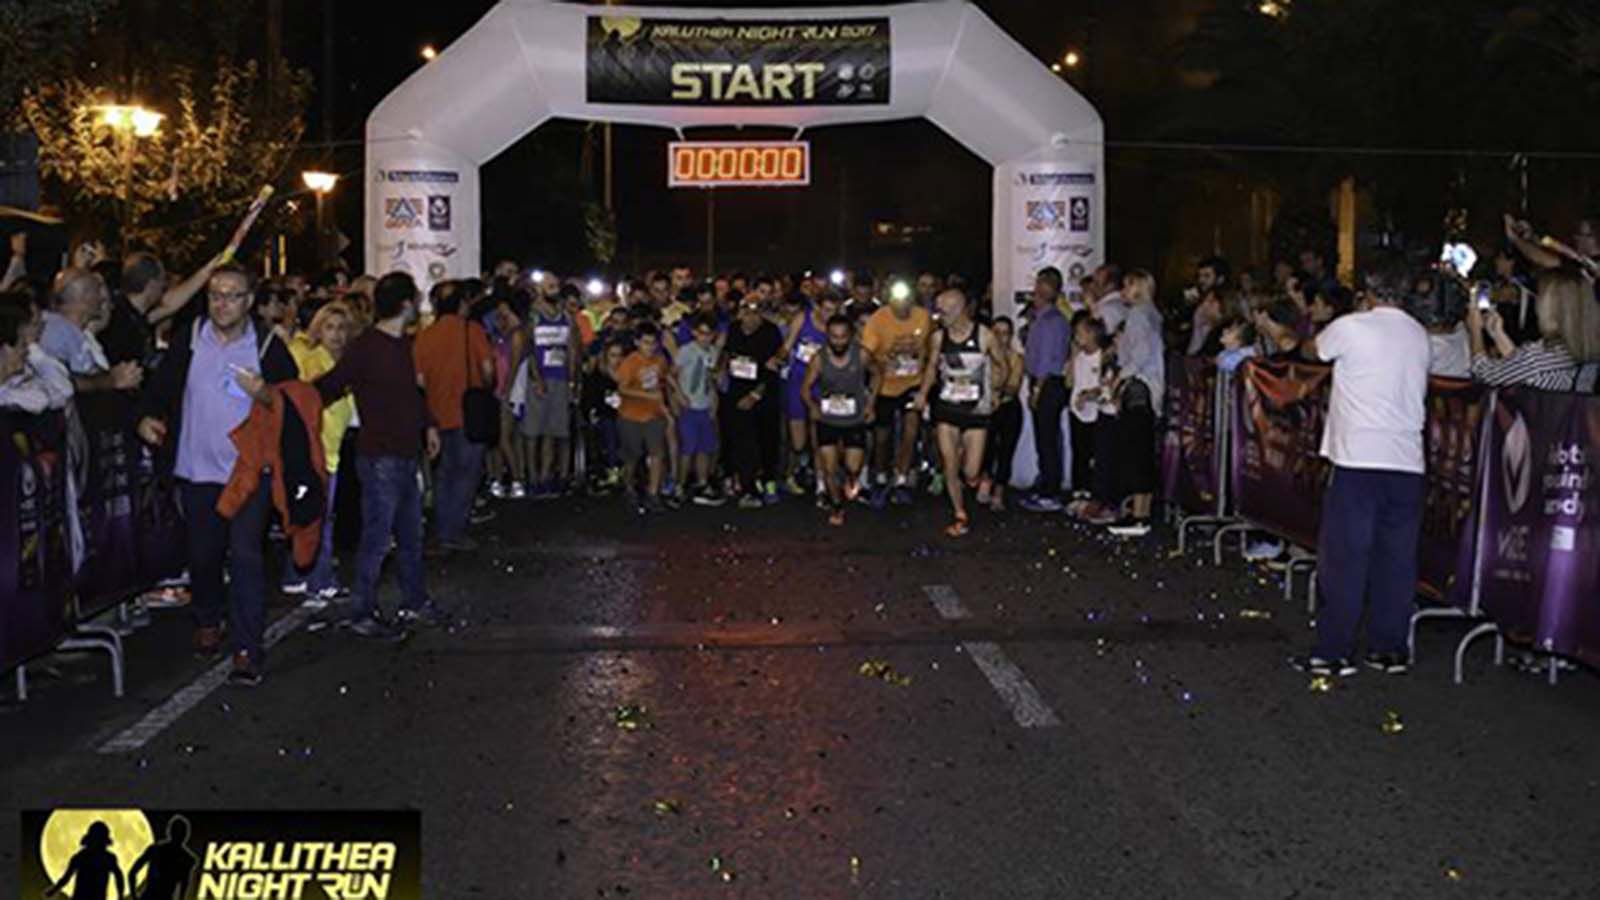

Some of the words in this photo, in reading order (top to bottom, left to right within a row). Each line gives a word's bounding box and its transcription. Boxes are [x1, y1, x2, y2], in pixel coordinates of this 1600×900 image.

[737, 25, 797, 40] NIGHT
[802, 25, 838, 39] RUN
[671, 62, 826, 100] START
